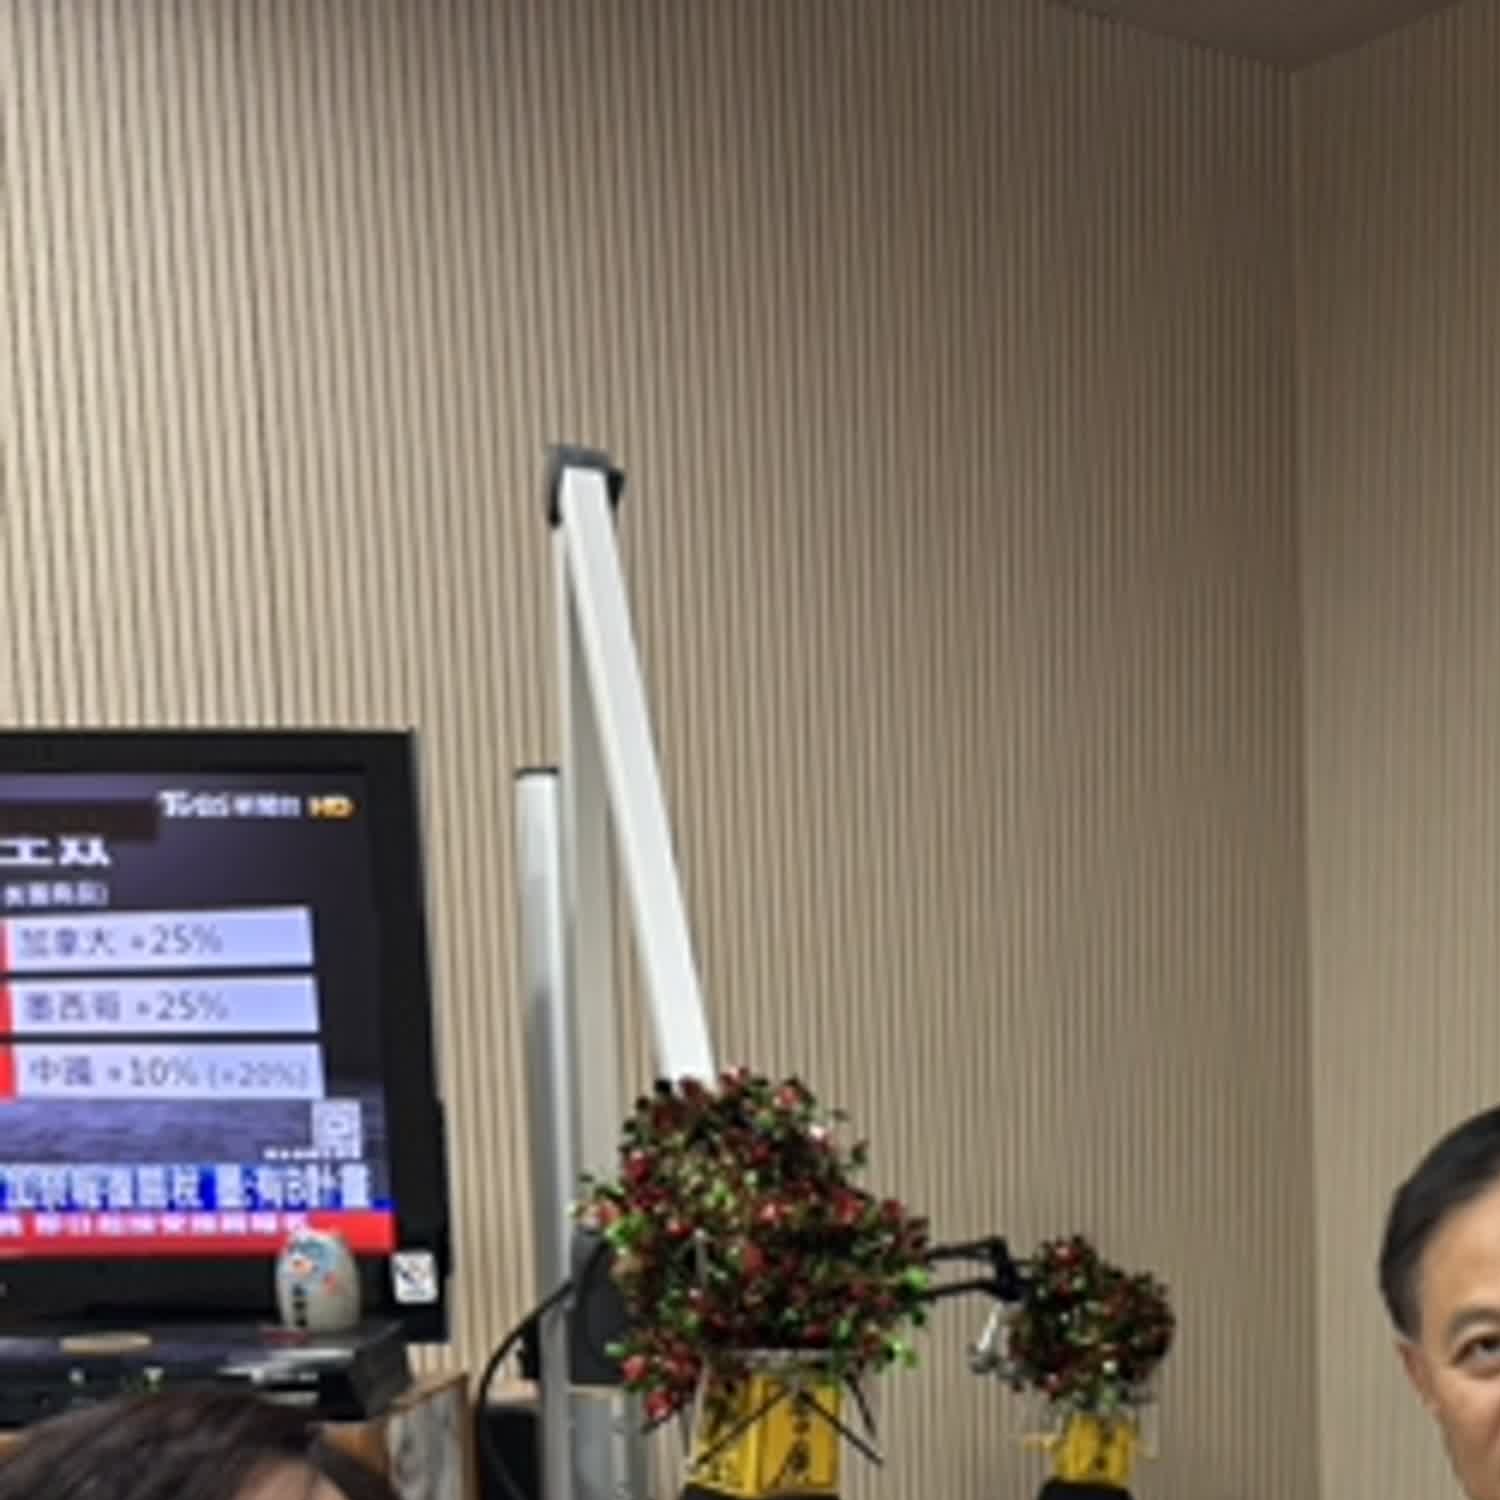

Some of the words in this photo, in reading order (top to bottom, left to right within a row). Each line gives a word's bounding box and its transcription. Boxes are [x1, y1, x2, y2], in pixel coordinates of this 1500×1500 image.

[308, 795, 354, 819] HD
[21, 927, 116, 957] 加拿大
[131, 924, 223, 956] +25%
[26, 990, 121, 1022] 墨西哥
[136, 989, 229, 1021] +25%
[107, 1054, 199, 1087] +10%
